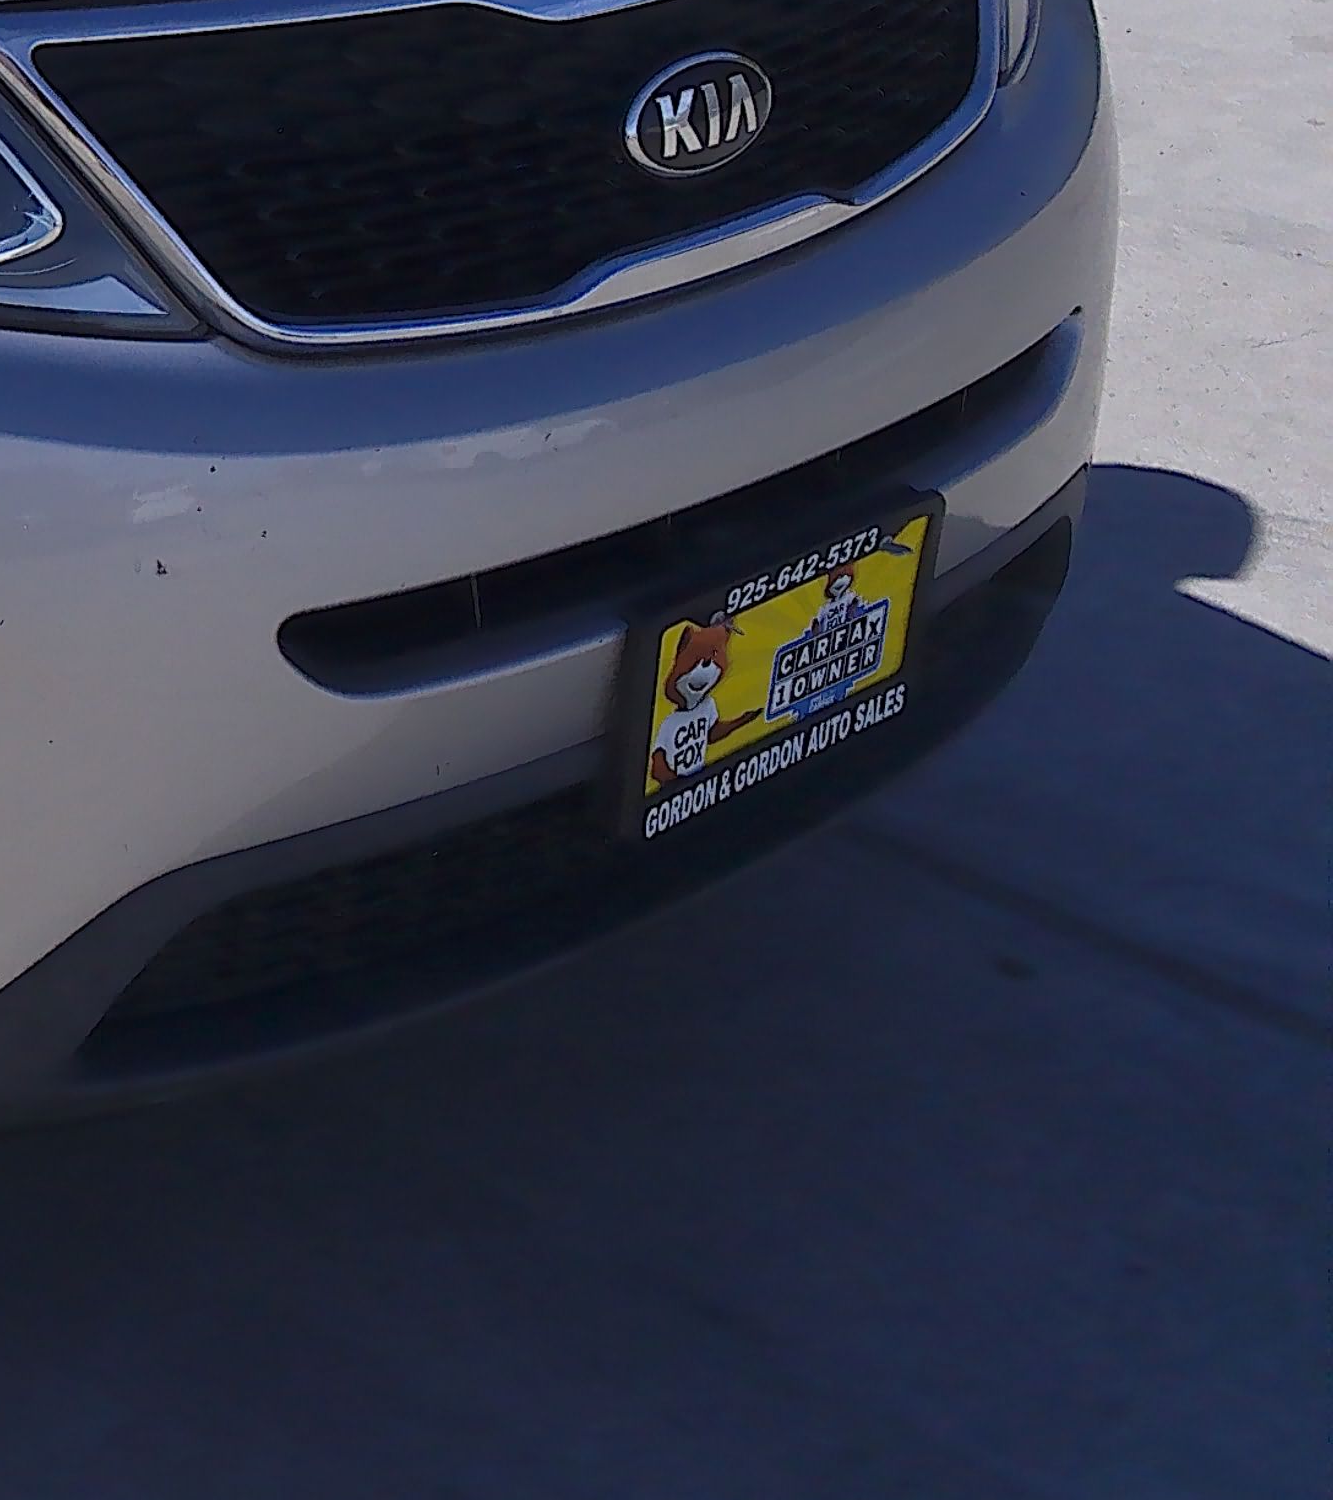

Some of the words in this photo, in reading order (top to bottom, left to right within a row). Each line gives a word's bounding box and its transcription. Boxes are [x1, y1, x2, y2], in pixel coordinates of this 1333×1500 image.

[655, 73, 758, 158] KIA
[726, 527, 879, 614] 925-642-5373
[780, 616, 882, 675] CARFAX
[794, 644, 876, 698] OWNER
[645, 776, 718, 839] GORDON
[719, 770, 731, 800] &
[734, 732, 804, 793] GORDON
[807, 710, 851, 757] AUTO
[854, 684, 906, 733] SALES
[674, 717, 706, 749] CAR
[674, 741, 705, 770] FOX
